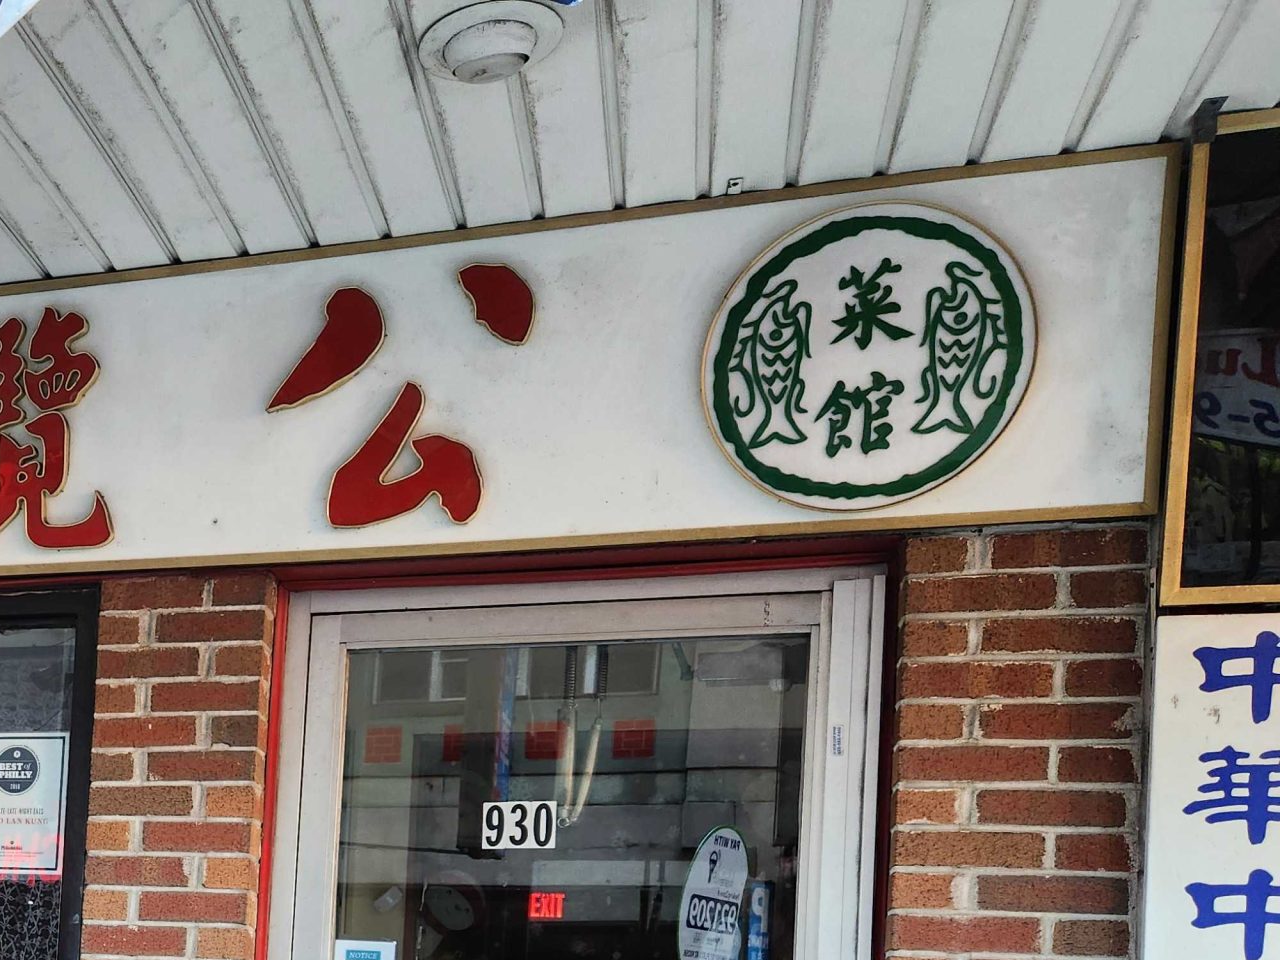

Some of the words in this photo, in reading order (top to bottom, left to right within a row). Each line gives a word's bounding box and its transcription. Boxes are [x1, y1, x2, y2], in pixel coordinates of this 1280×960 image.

[814, 257, 915, 457] 菜館
[0, 762, 23, 771] BEST
[6, 817, 22, 825] LAN
[24, 817, 49, 825] KUNG
[485, 803, 554, 848] 930
[529, 892, 565, 918] EXIT
[349, 951, 377, 960] NOTICE
